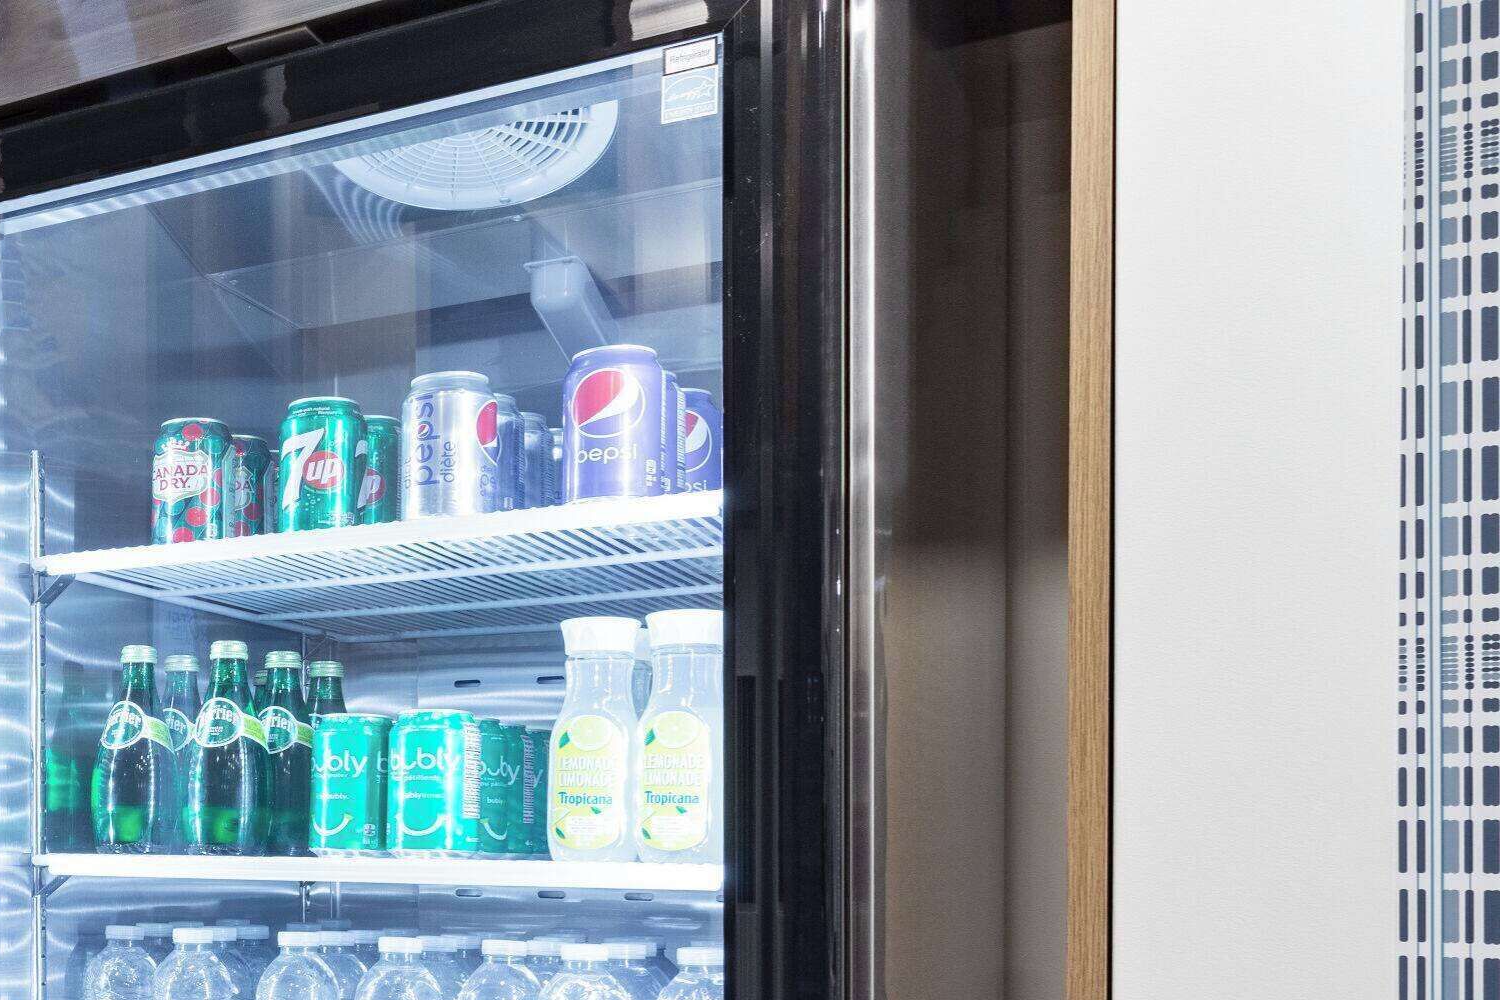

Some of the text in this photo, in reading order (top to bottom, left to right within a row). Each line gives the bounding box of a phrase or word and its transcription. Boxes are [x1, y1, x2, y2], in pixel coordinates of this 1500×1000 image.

[574, 443, 637, 464] pepsi
[558, 791, 613, 806] Tropicana
[644, 790, 700, 806] Tropicana
